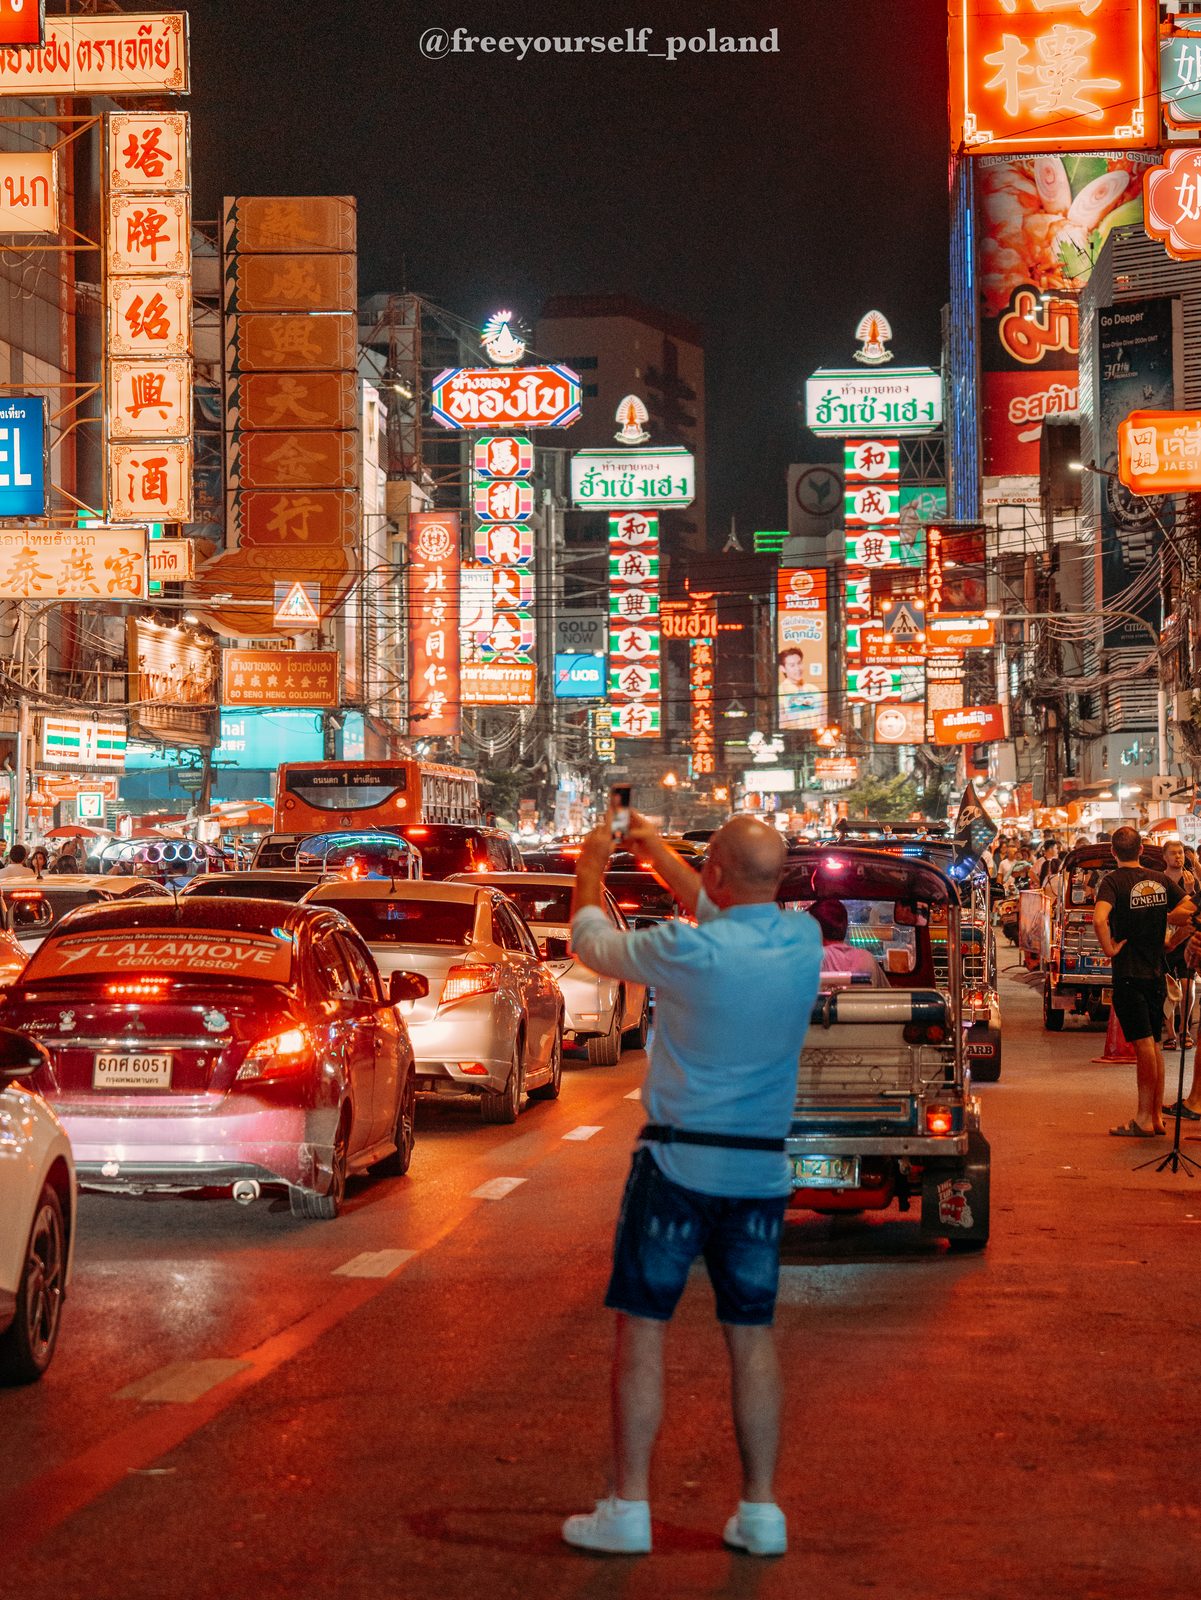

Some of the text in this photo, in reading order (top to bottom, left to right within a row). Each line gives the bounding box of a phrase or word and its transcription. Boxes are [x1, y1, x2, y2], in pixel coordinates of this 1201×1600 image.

[984, 0, 1122, 120] 樓
[1101, 312, 1144, 326] Go Deeper
[622, 516, 648, 724] 和成興大金行
[558, 621, 598, 633] GOLD
[1124, 622, 1153, 632] CITIZ
[422, 565, 448, 720] 北京同仁堂
[563, 632, 594, 643] NOW
[570, 669, 600, 681] UOB
[243, 691, 263, 699] SENG
[265, 691, 286, 699] HENG
[288, 691, 332, 699] GOLDSMITH
[342, 773, 349, 785] 1
[1132, 895, 1166, 906] O'NEILL
[96, 943, 276, 964] LALAMOVE
[117, 956, 242, 970] deliver faster
[967, 1044, 993, 1056] ARB
[133, 1059, 168, 1072] 6051
